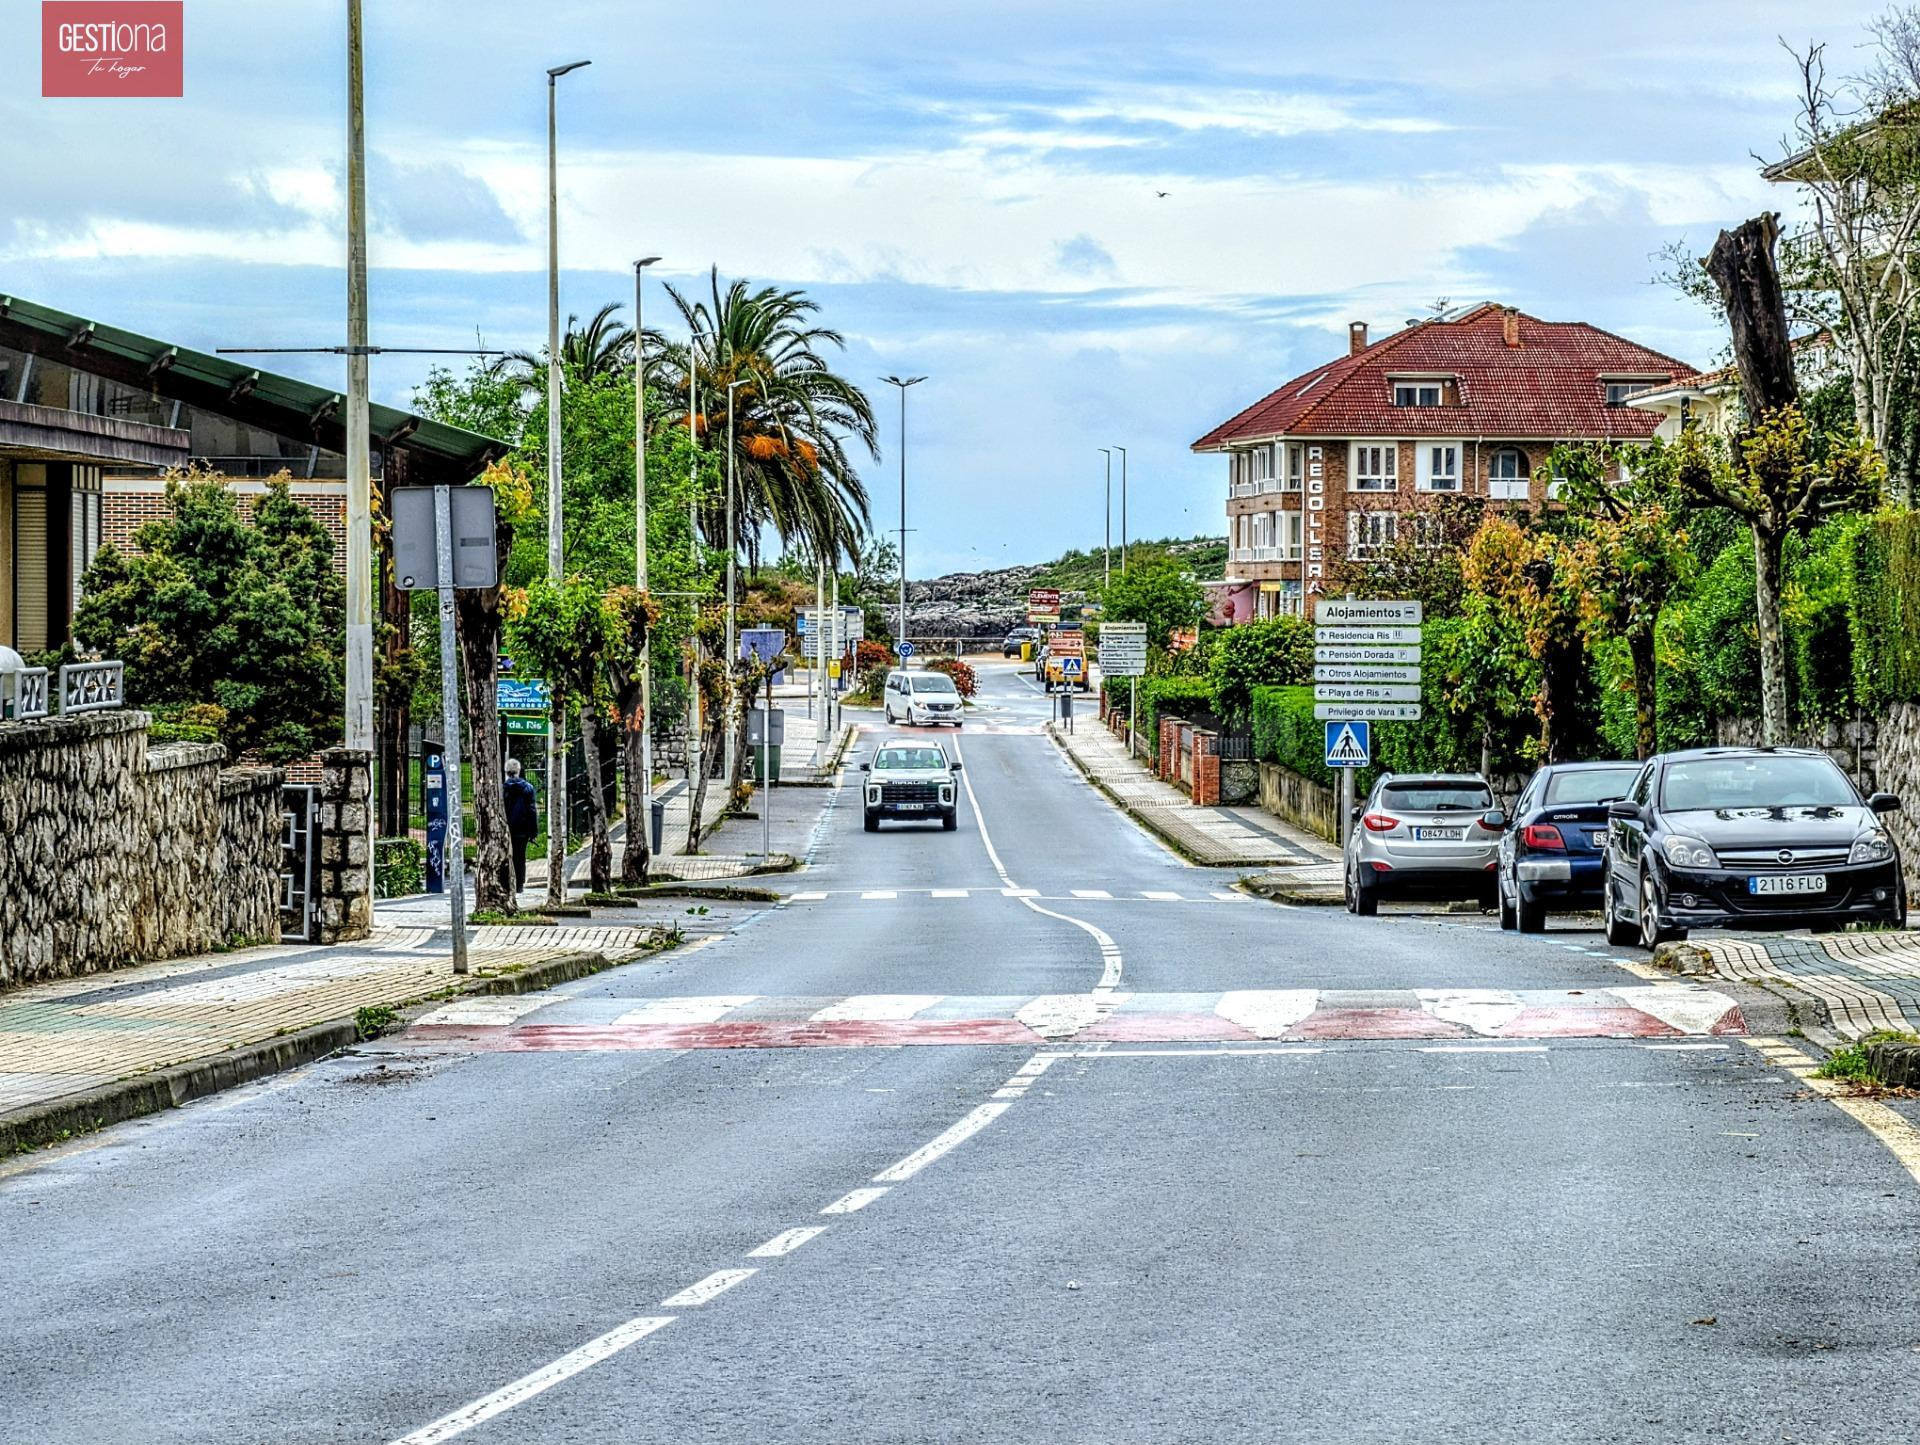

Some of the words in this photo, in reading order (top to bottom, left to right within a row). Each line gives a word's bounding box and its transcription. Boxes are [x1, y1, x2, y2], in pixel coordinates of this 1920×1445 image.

[1308, 446, 1324, 595] REGOLLERA
[1326, 607, 1401, 619] Alojamientos
[1328, 631, 1375, 640] Residencia
[1376, 632, 1390, 640] Ris
[1328, 650, 1361, 659] Pensión
[1364, 650, 1394, 659] Dorada
[1328, 669, 1351, 678] Otros
[1353, 669, 1407, 679] Alojamientos
[1328, 688, 1348, 698] Playa
[1353, 688, 1364, 697] de
[1366, 689, 1380, 697] Ris
[1328, 708, 1364, 718] Privilegio
[1365, 708, 1376, 716] de
[1377, 708, 1395, 716] Vara
[1422, 830, 1443, 838] 0847
[1759, 878, 1794, 892] 2116
[1798, 876, 1823, 890] FLG
